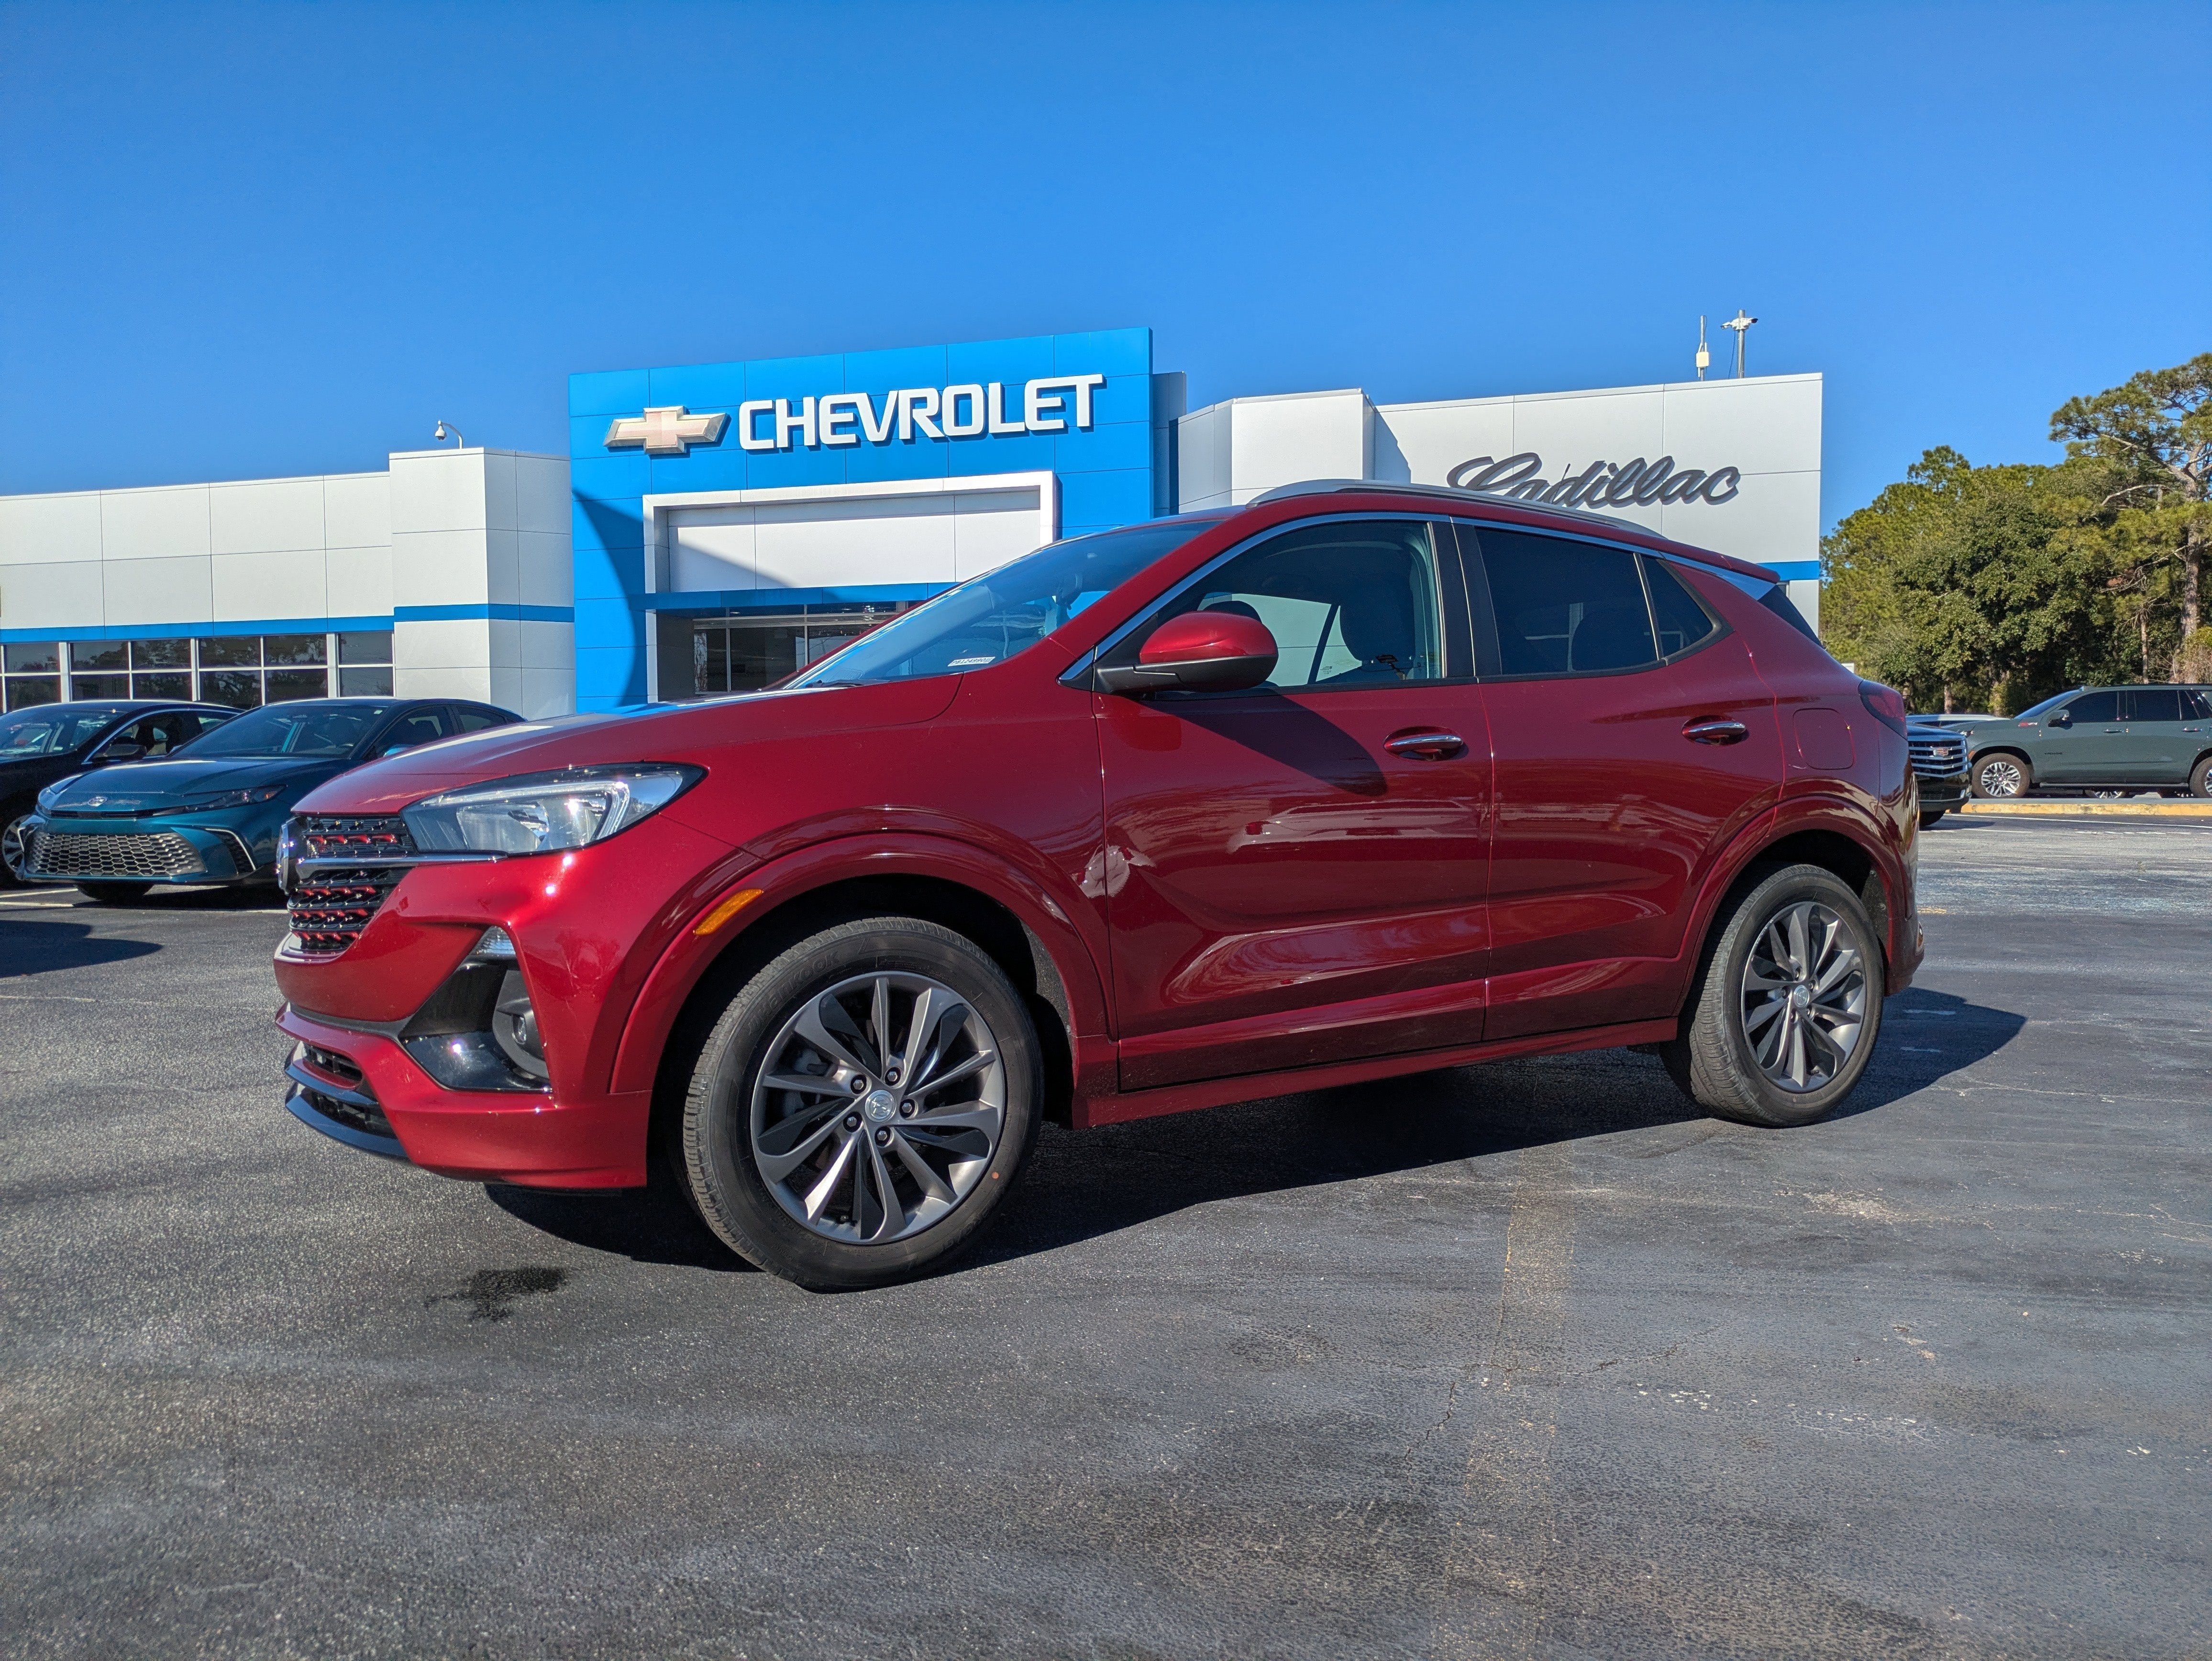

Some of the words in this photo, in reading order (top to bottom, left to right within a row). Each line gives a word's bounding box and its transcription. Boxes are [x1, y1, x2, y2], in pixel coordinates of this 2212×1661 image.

[739, 374, 1103, 450] CHEVROLET
[1447, 452, 1740, 508] Cadillac
[756, 950, 840, 1023] Hankook
